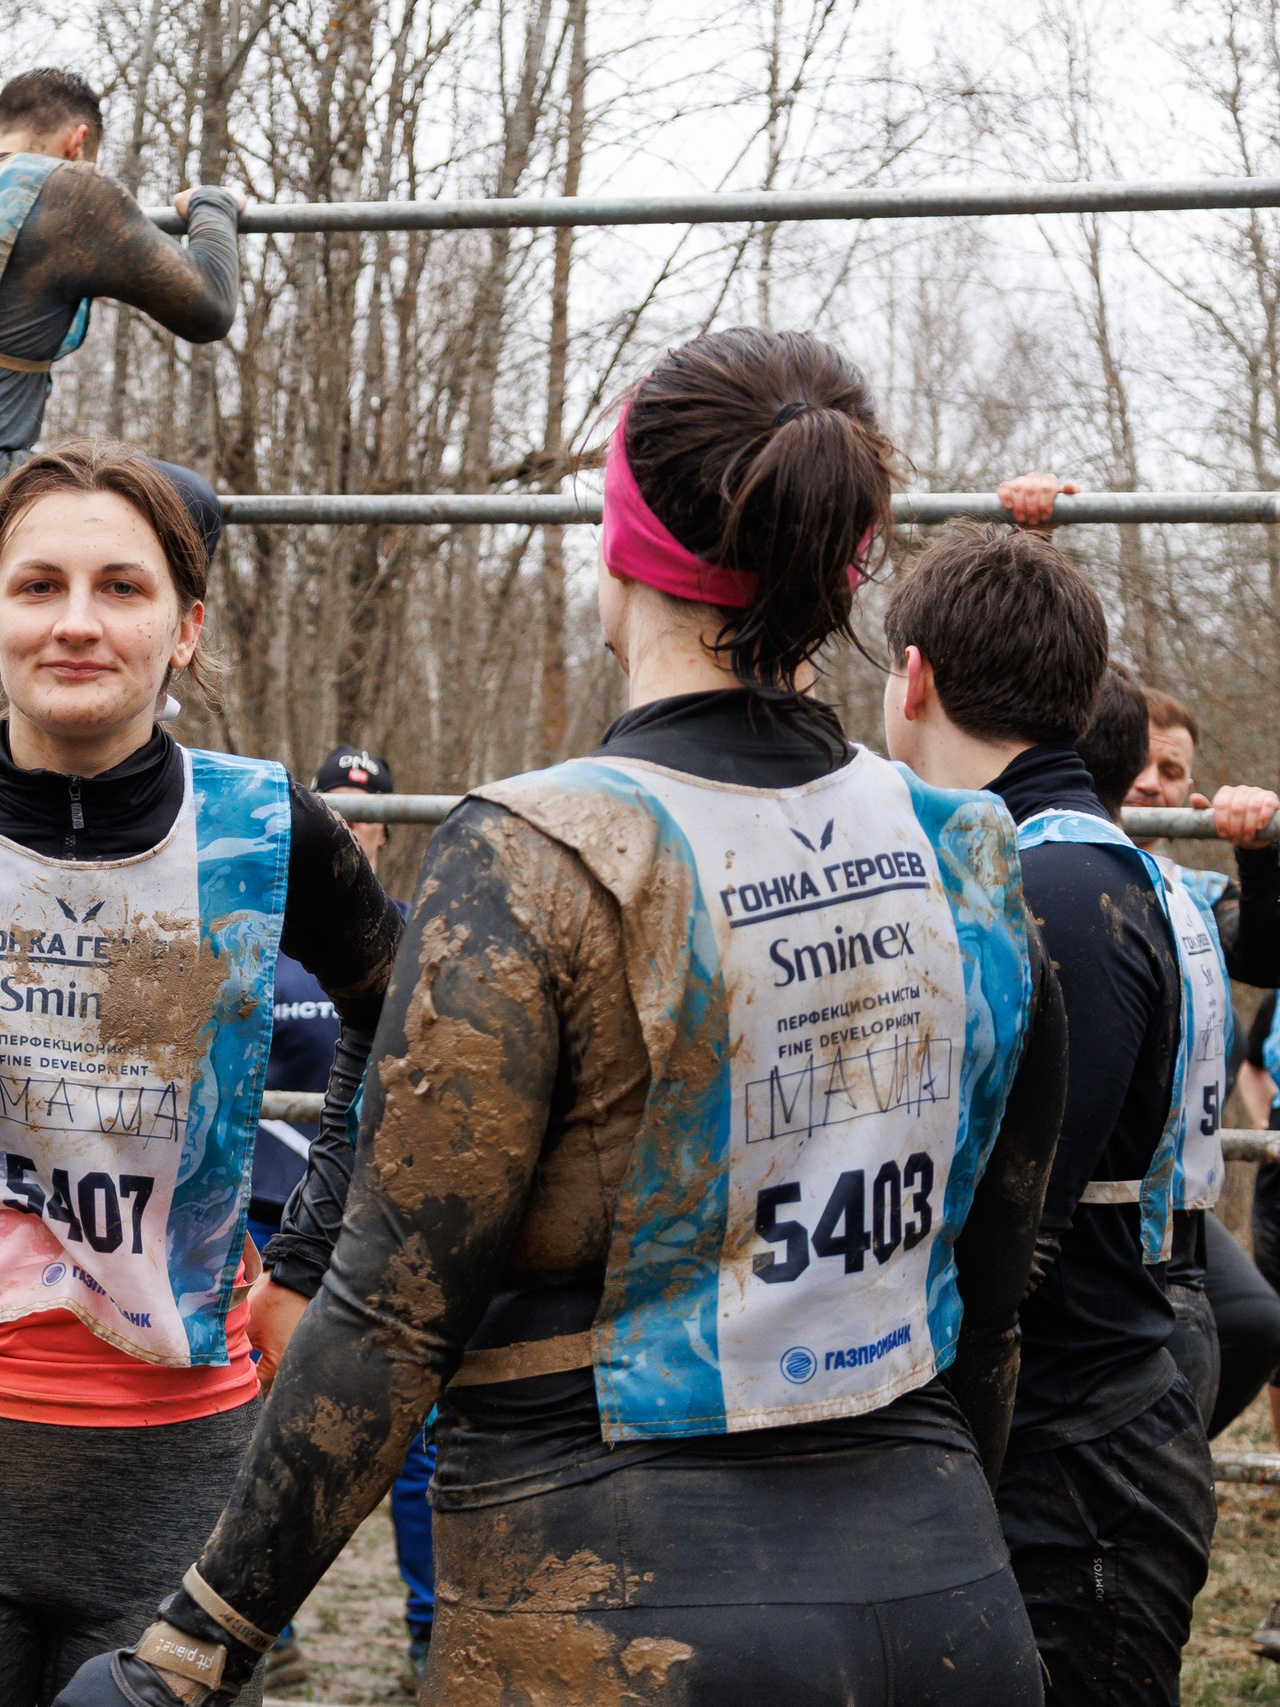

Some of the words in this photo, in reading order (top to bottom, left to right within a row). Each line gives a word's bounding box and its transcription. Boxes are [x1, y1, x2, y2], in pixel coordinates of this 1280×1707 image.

[720, 871, 821, 916] ГОНКА
[823, 851, 926, 892] ГЕРОЕВ
[770, 922, 915, 987] Sminex
[0, 976, 102, 1020] Smin
[777, 985, 920, 1033] ПЕРФЕКЦИОНИСТЫ
[778, 1038, 813, 1059] FINE
[819, 1011, 921, 1048] DEVELOPMENT
[0, 1054, 32, 1067] FINE
[2, 1153, 155, 1254] 5407
[752, 1151, 934, 1284] 5403
[824, 1323, 912, 1371] ГАЗПРОМБАНК
